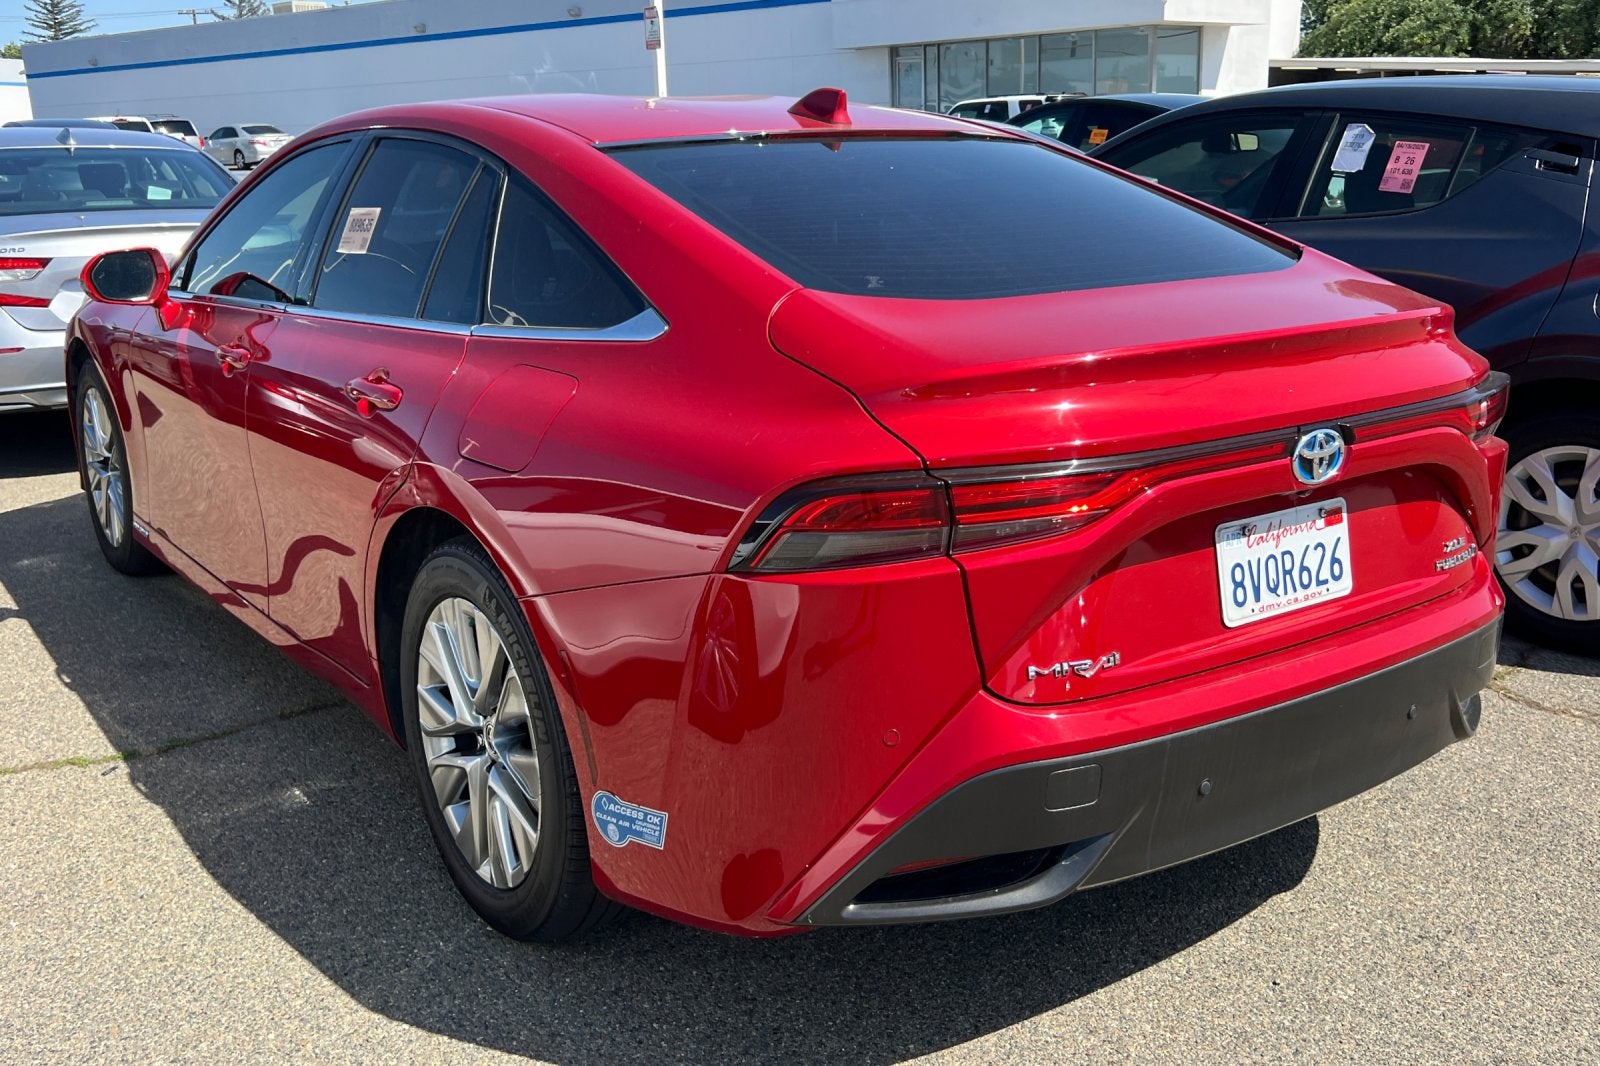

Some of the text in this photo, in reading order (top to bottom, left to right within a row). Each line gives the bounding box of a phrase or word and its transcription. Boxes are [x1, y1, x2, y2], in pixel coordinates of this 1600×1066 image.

[1394, 155, 1416, 166] B 26
[1246, 519, 1325, 549] California
[1231, 537, 1344, 608] 8VQR626
[1258, 590, 1323, 613] dmv.ca.gov
[496, 610, 551, 745] MICHELIN
[1028, 651, 1120, 680] MIRAI
[596, 812, 660, 836] CLEAN AIR VEHICLE
[608, 803, 661, 825] ACCESS OK
